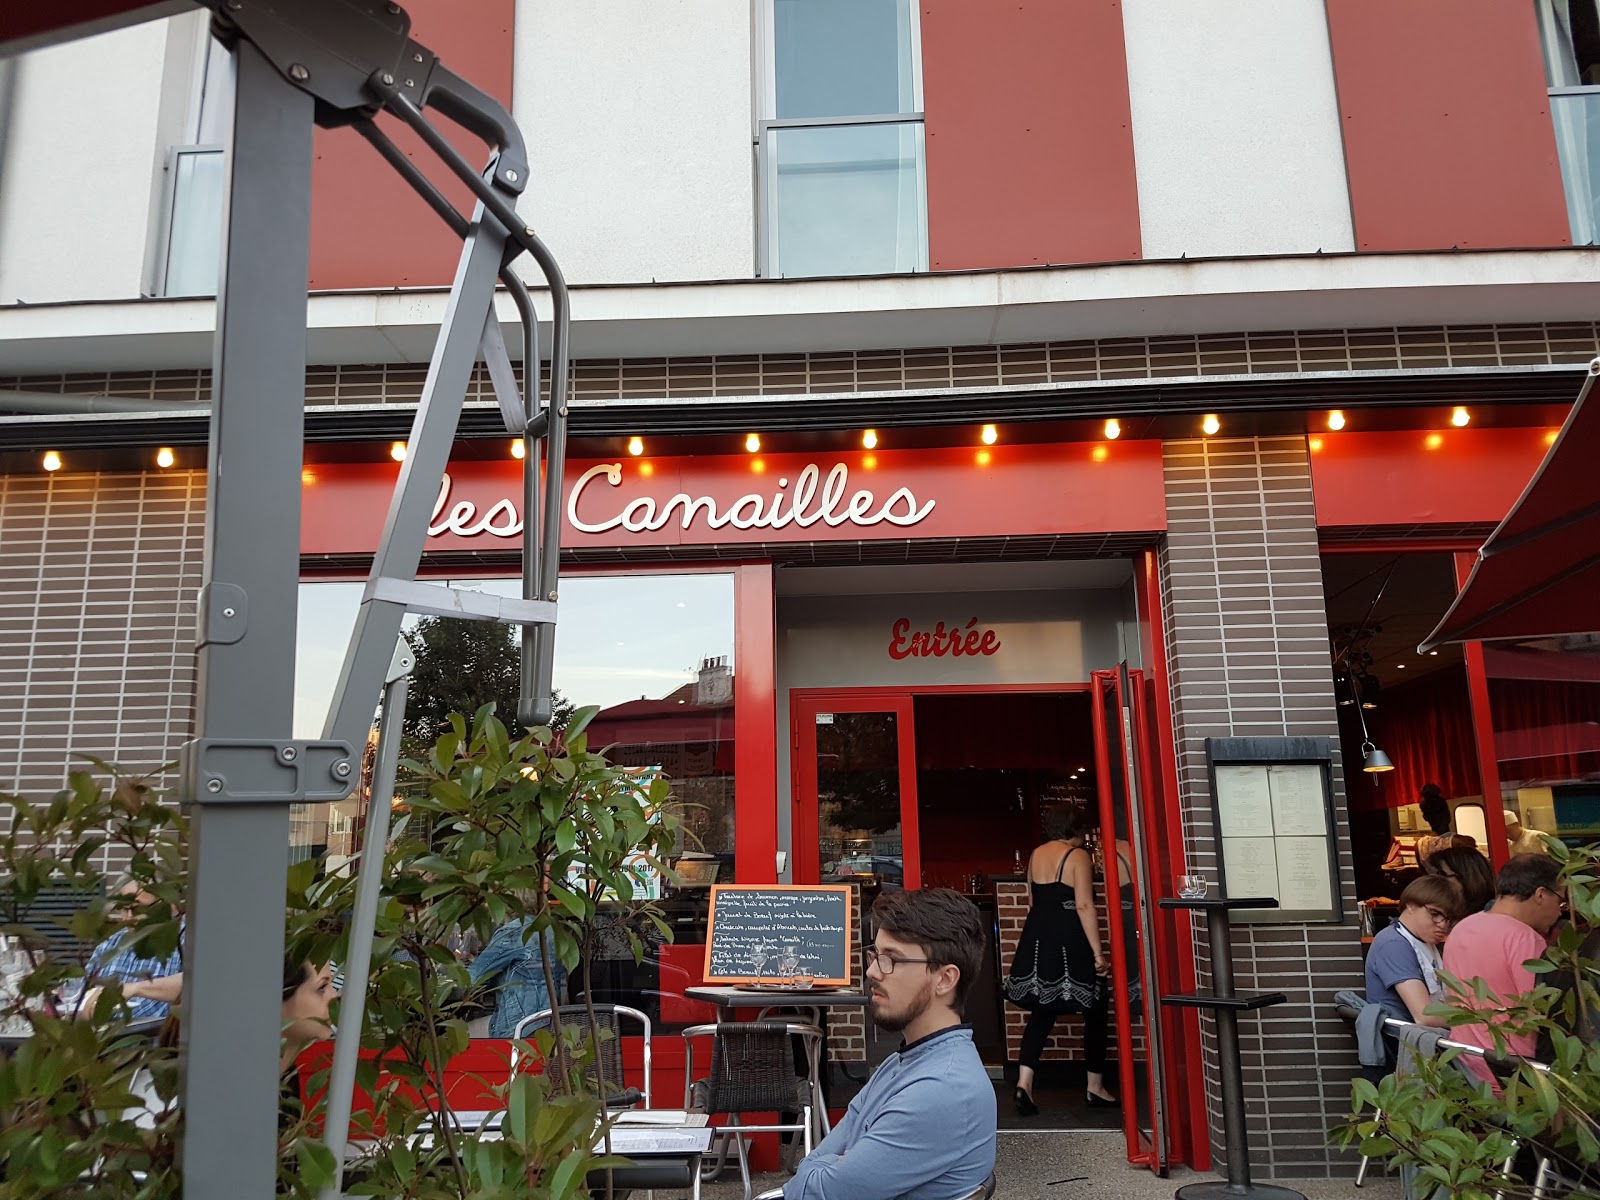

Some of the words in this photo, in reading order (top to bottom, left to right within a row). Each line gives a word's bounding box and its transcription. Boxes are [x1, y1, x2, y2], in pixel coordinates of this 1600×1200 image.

[567, 463, 936, 533] Canailles
[888, 616, 1001, 660] Entrée
[638, 864, 654, 872] 2017
